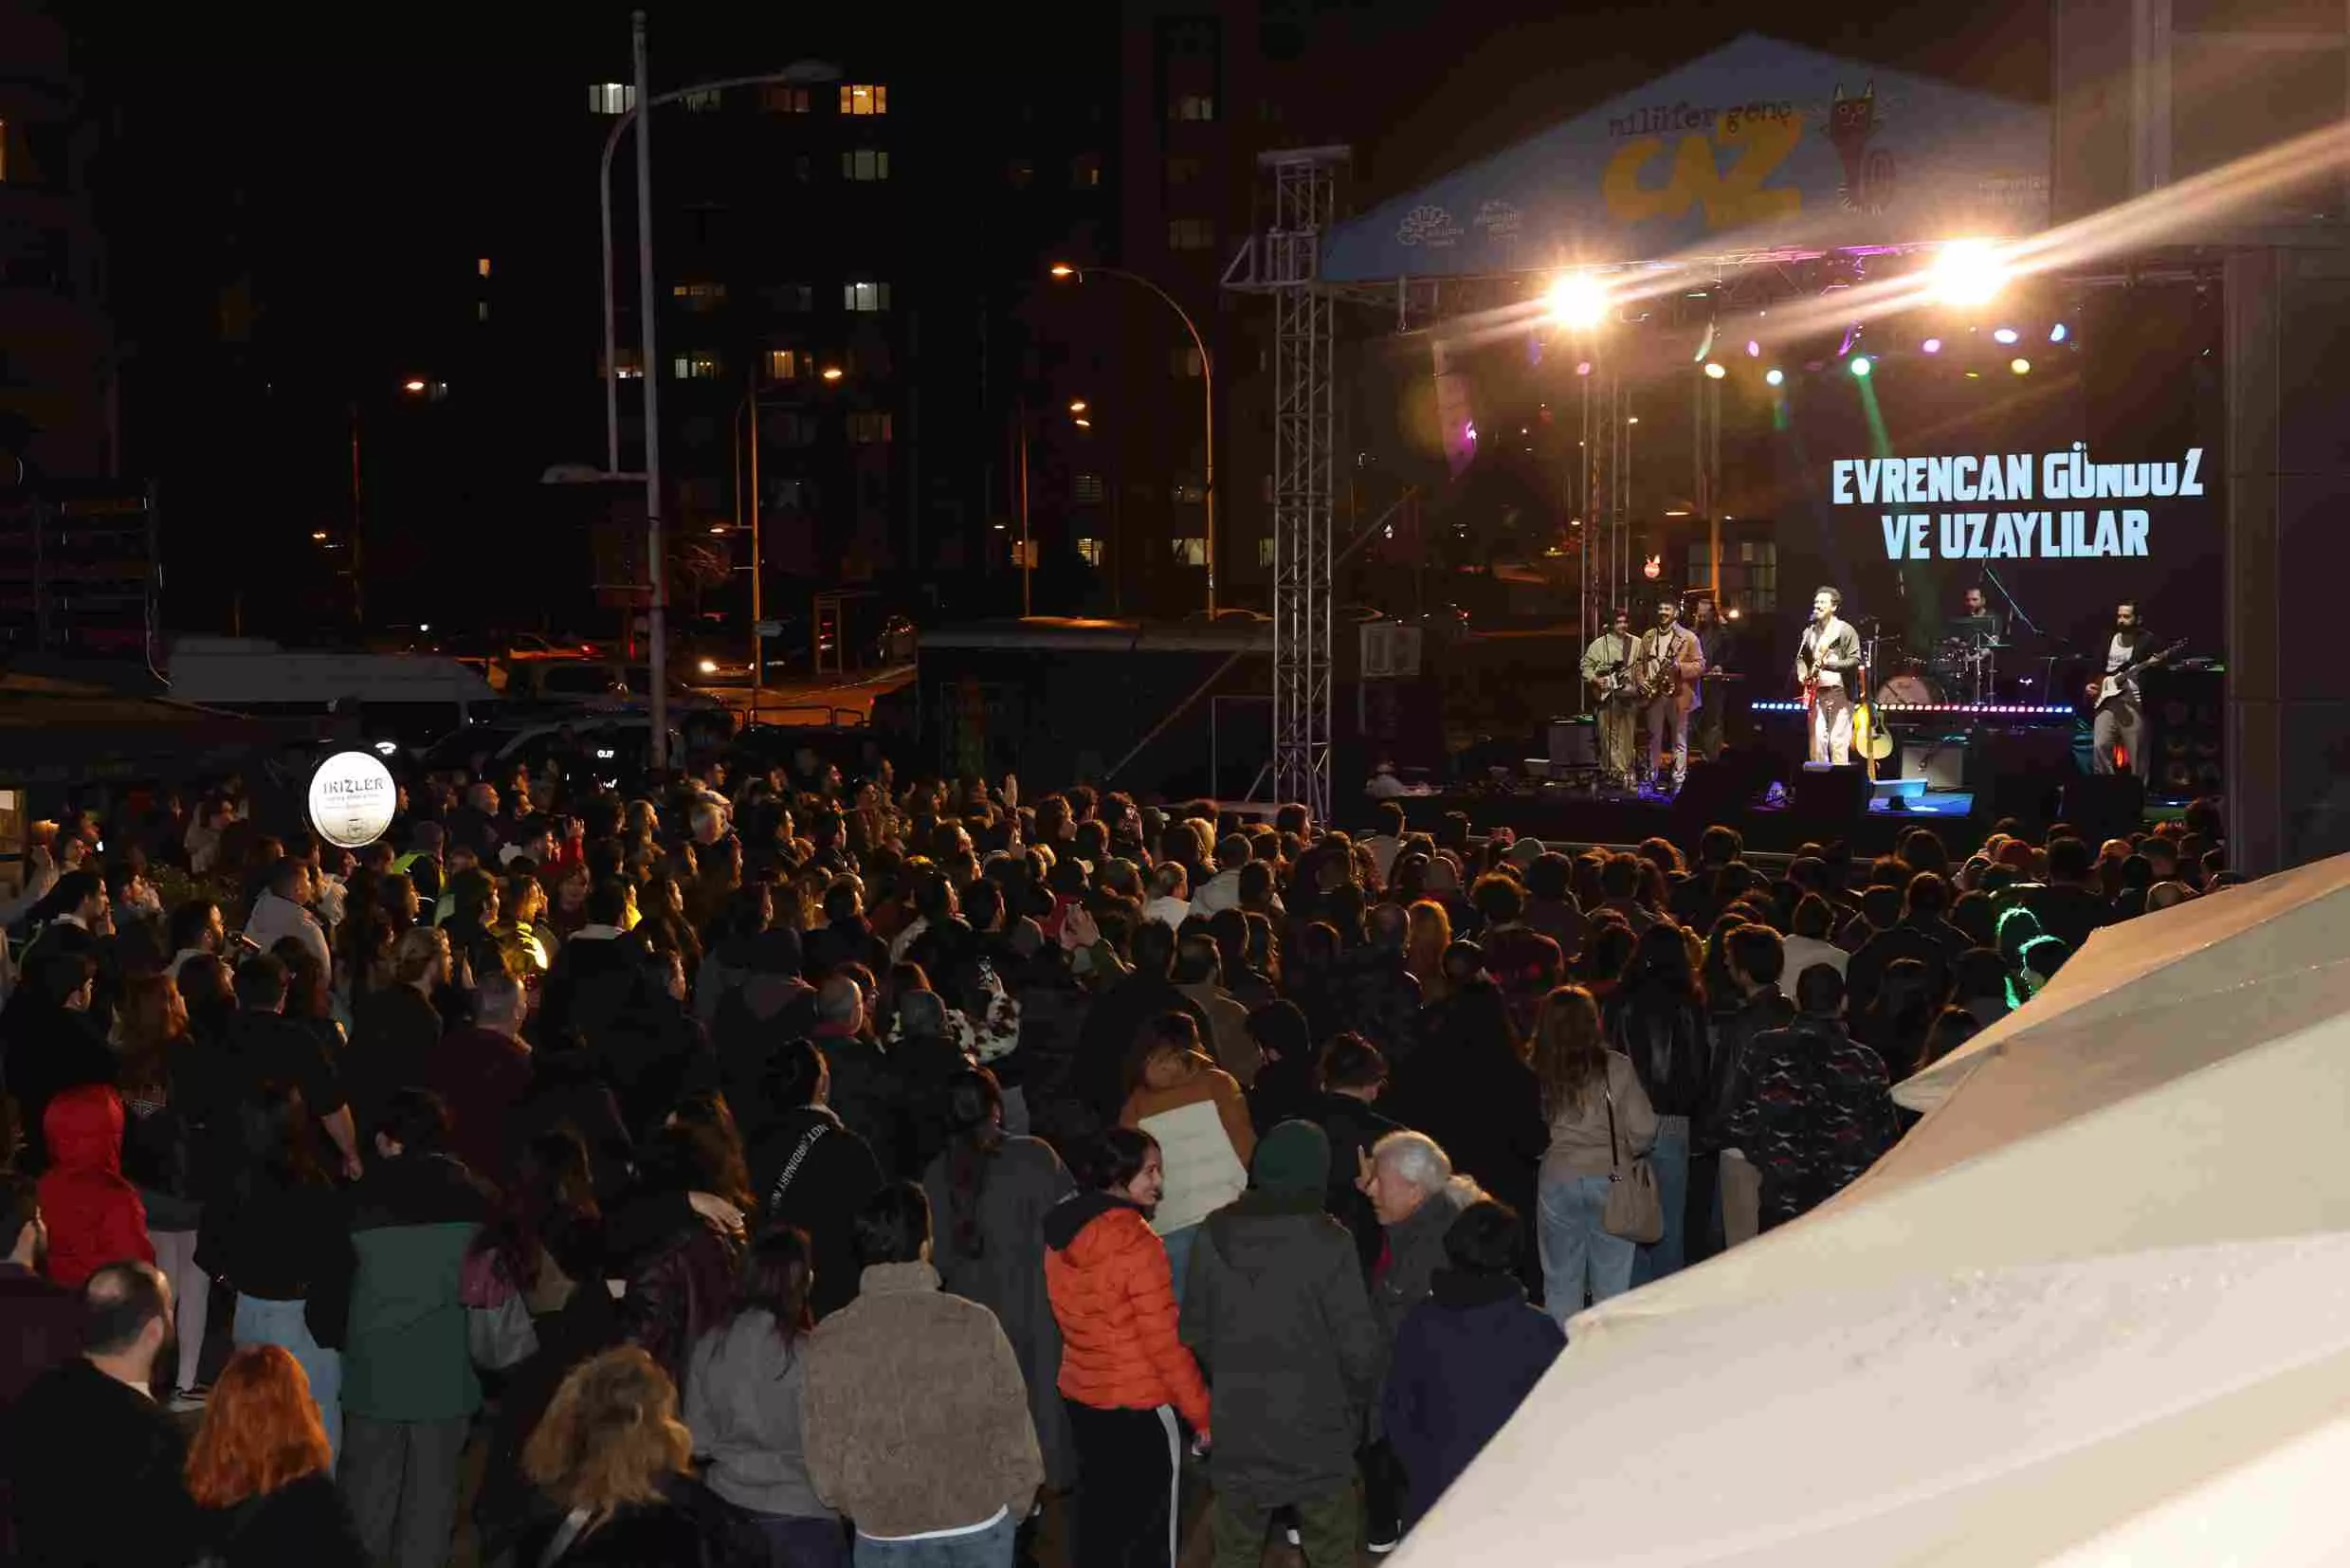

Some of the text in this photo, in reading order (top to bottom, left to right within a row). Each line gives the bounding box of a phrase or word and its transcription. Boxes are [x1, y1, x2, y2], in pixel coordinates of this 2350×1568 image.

[1600, 112, 1806, 228] CAZ
[1832, 454, 2033, 504] EVRENCAN
[1882, 509, 2149, 559] VE UZAYLILAR
